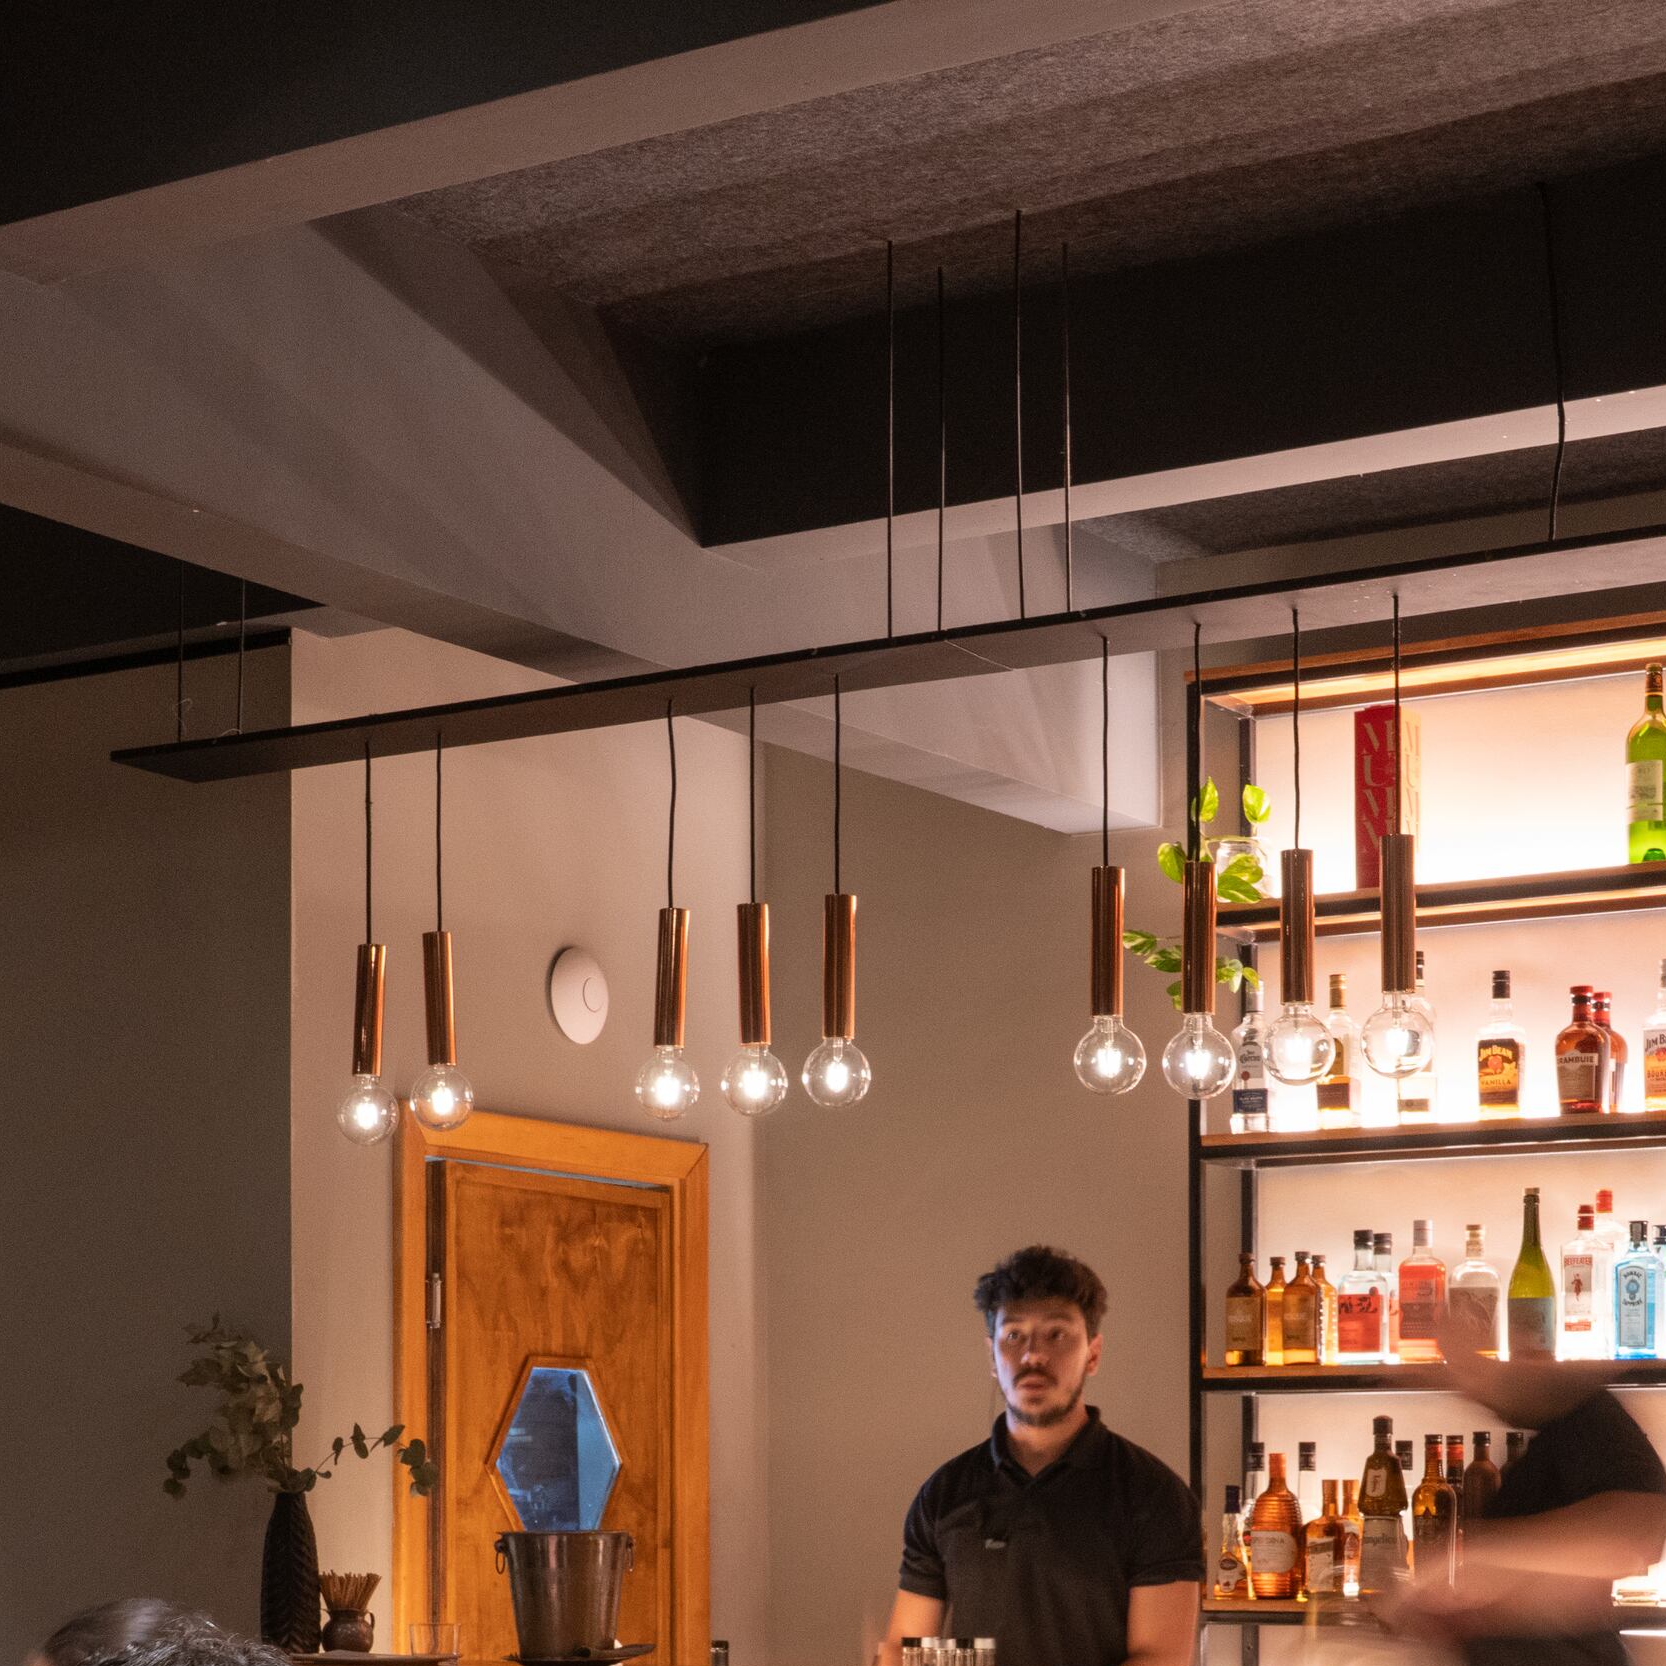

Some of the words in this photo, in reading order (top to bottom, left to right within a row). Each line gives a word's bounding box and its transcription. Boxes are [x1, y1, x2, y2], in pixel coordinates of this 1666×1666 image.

[1646, 1037, 1658, 1051] JIM
[1479, 1047, 1492, 1061] JIM
[1492, 1045, 1513, 1059] BEAM
[1564, 1257, 1593, 1266] BEEFEATER
